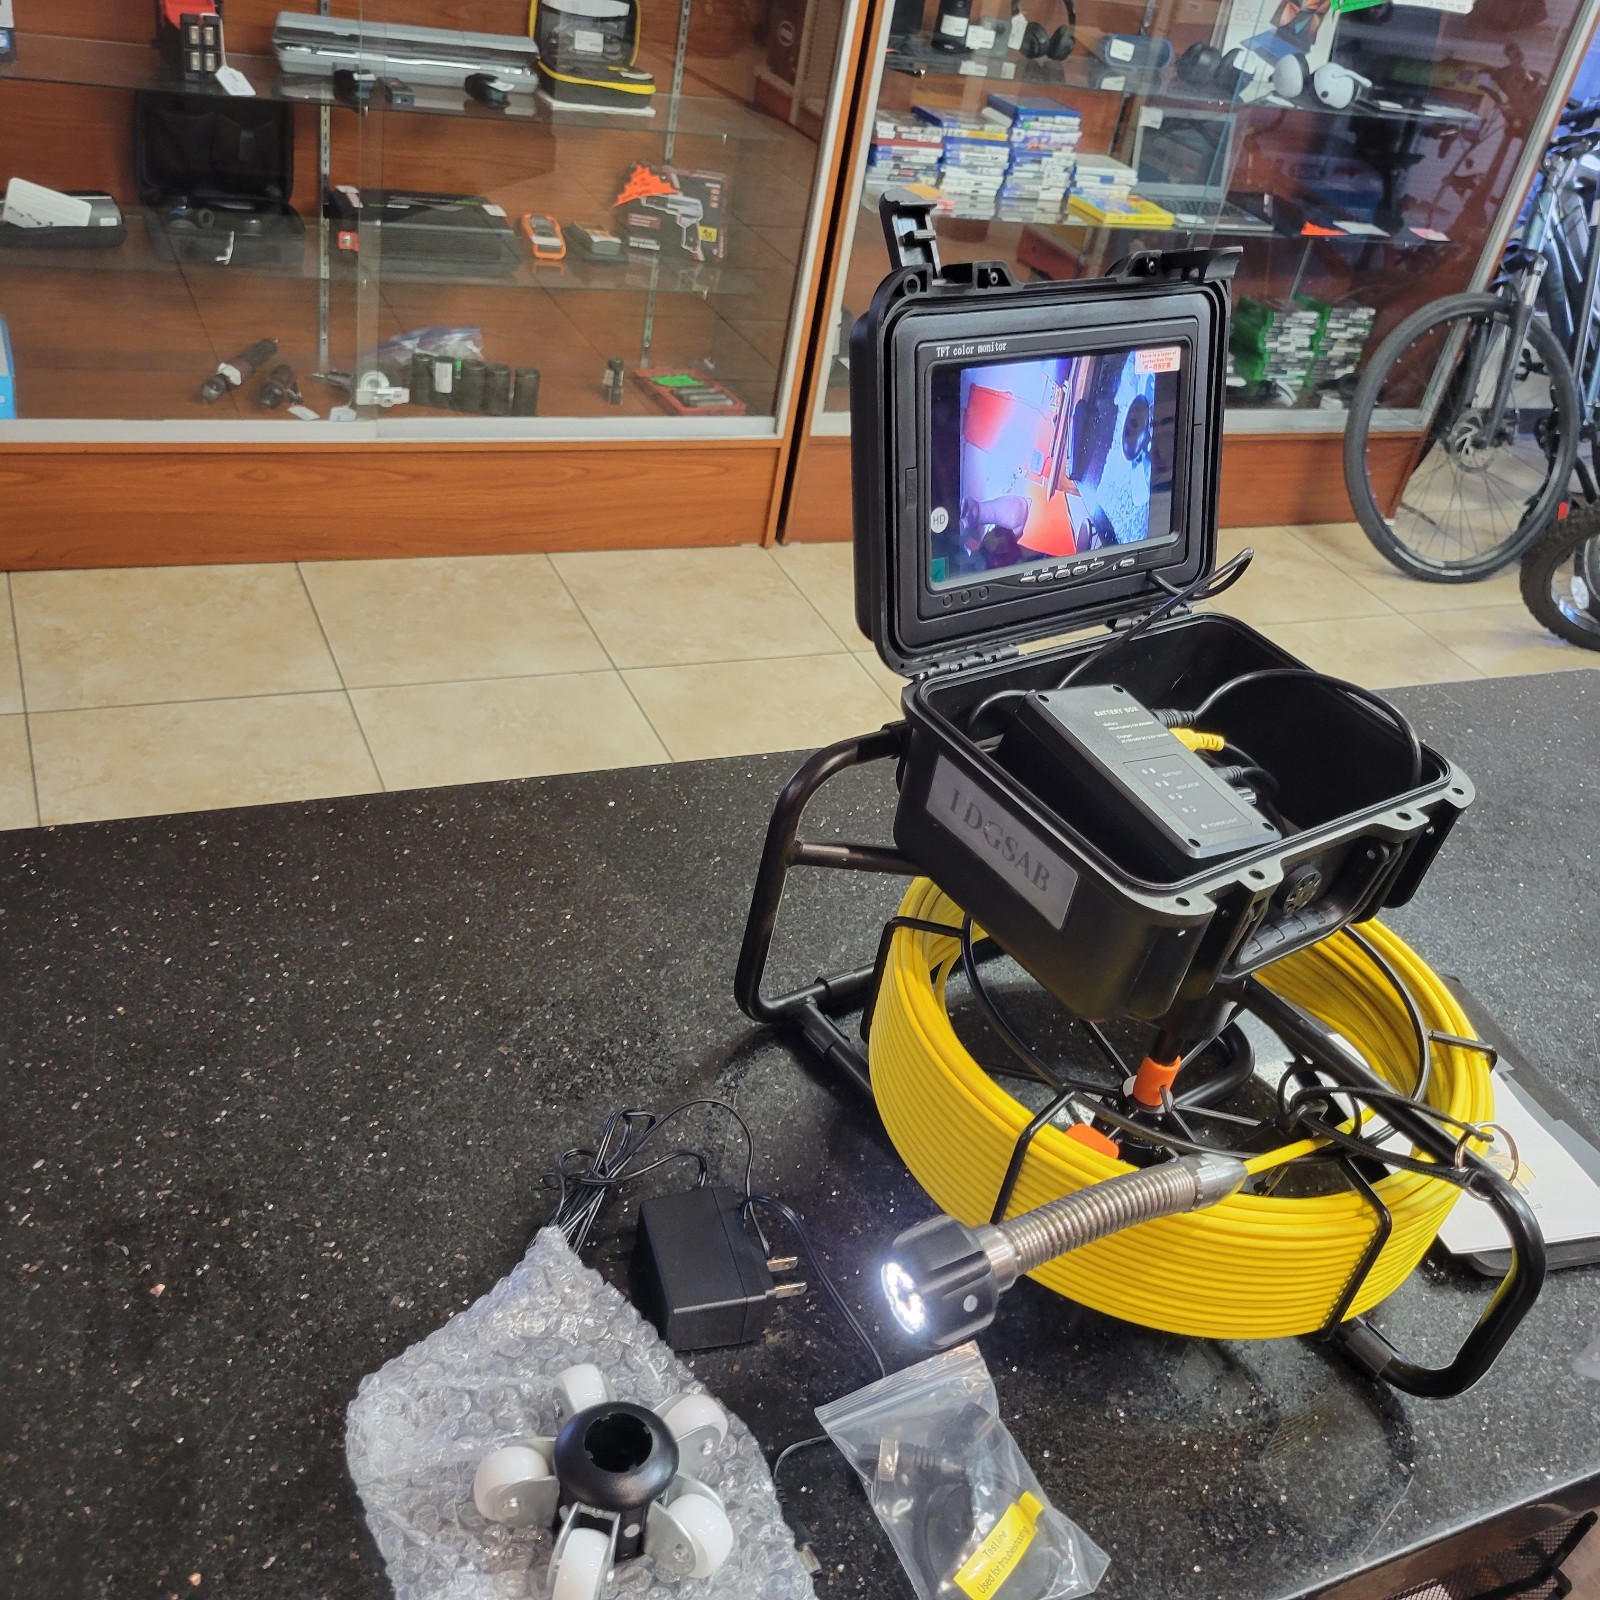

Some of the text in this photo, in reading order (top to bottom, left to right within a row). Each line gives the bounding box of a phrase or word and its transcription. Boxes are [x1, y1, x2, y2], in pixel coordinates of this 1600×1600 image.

[936, 341, 1007, 358] TFT color monitor
[932, 514, 946, 526] HD
[1093, 705, 1140, 717] BATTERY BOX
[982, 1541, 999, 1558] Test
[977, 1574, 995, 1594] Used
